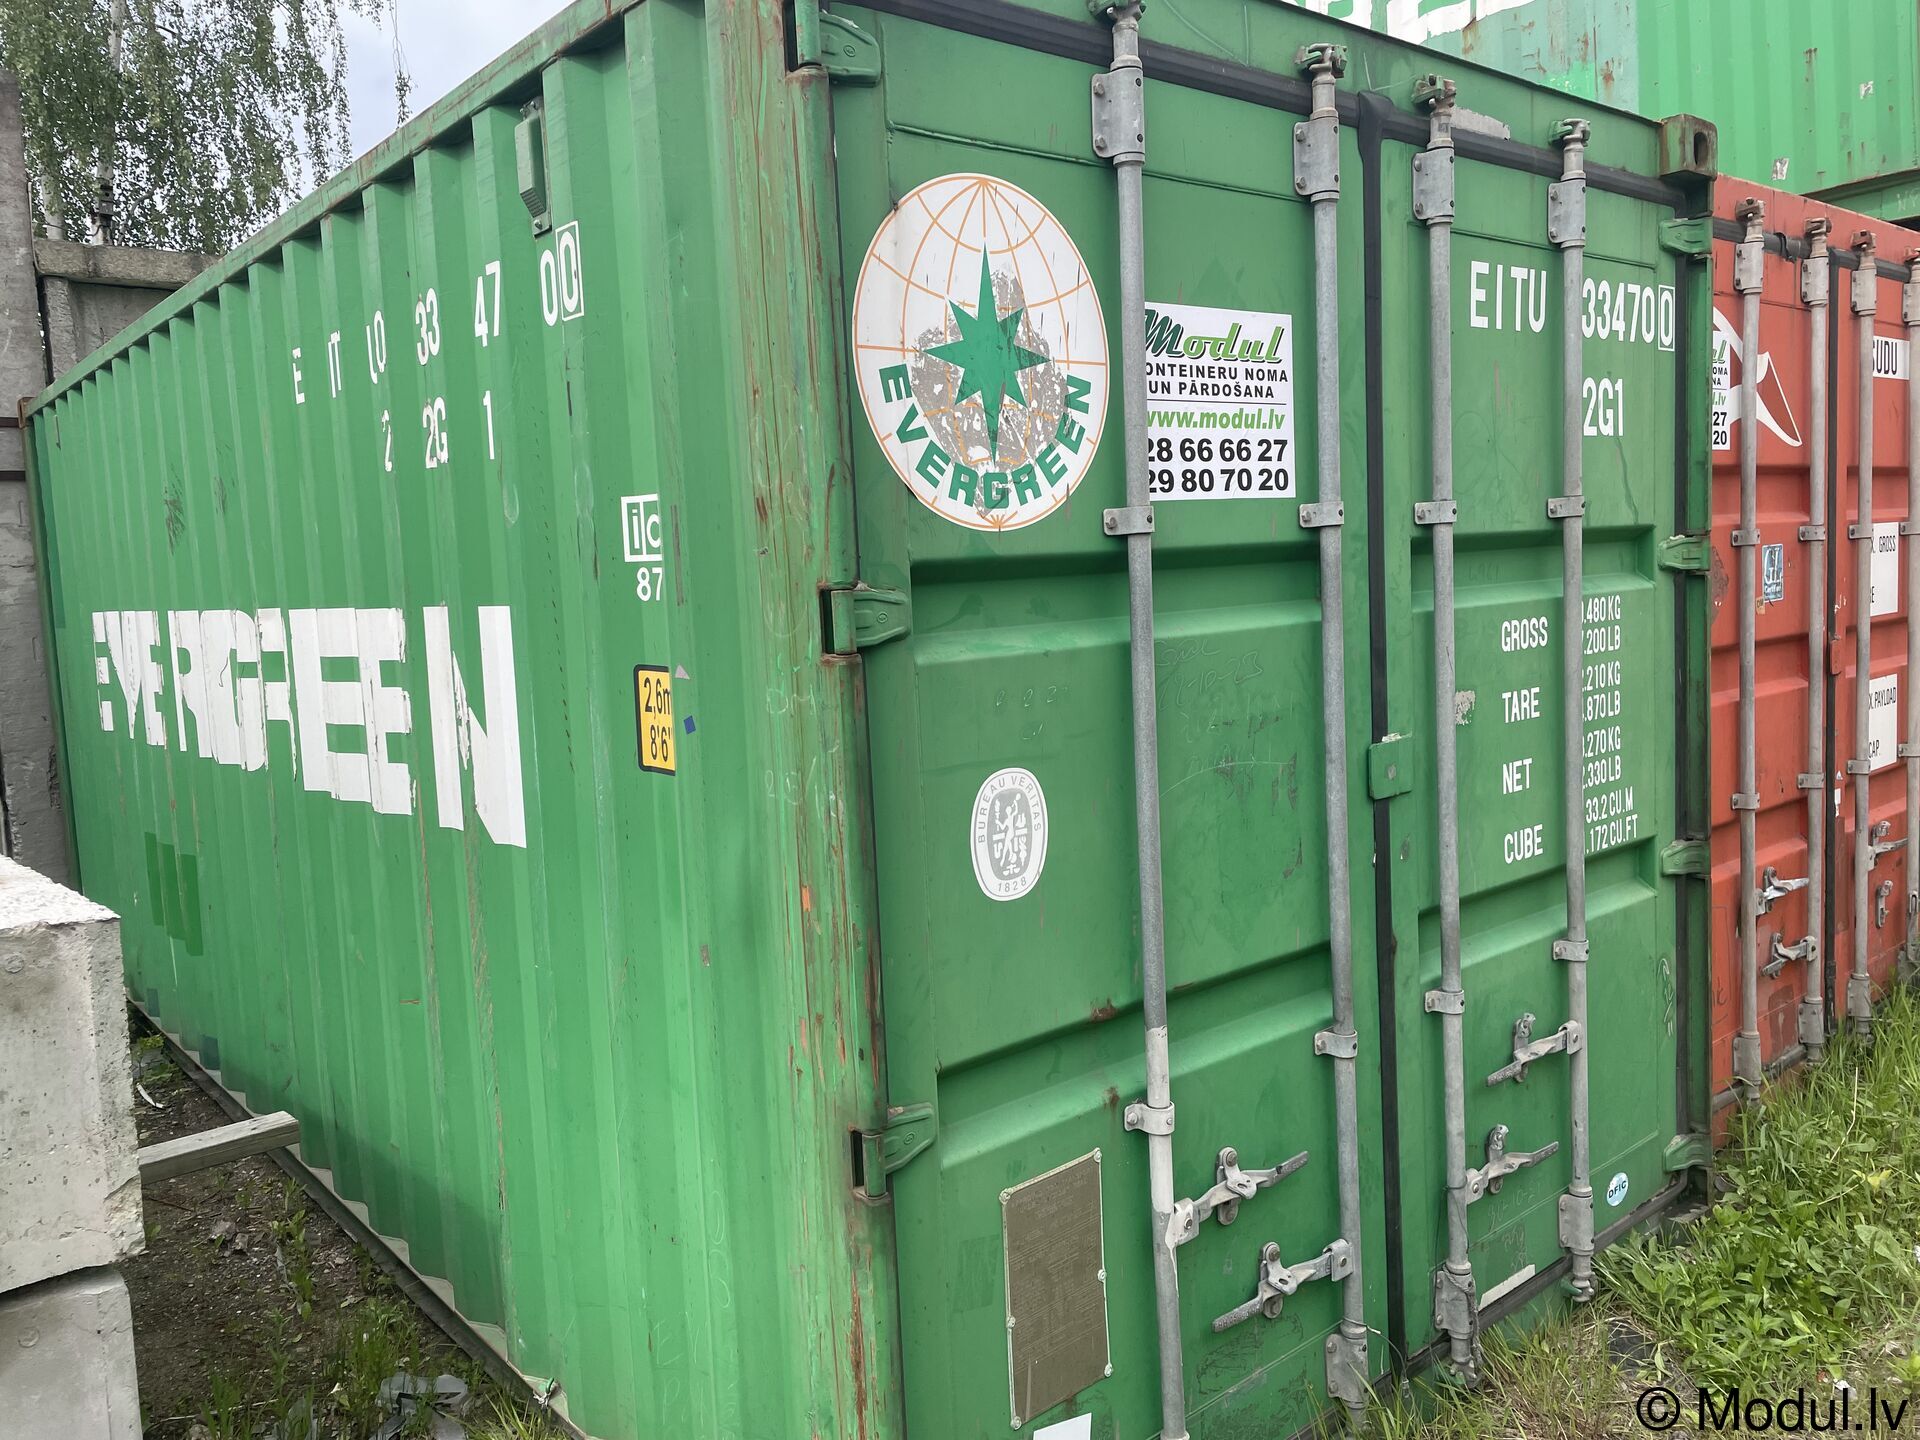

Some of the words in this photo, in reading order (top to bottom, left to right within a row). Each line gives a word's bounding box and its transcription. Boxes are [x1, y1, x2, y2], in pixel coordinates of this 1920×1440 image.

[1471, 261, 1547, 333] EITU
[1145, 308, 1285, 364] Modul
[1146, 362, 1238, 380] ONTEINERU
[1245, 368, 1288, 382] NOMA
[1712, 366, 1728, 376] OMA
[1149, 380, 1171, 395] UN
[1178, 380, 1274, 399] PĀRDOŠANA
[1582, 376, 1624, 437] 2G1
[879, 362, 1093, 510] EVERGREEN
[1179, 437, 1213, 463] 66
[1219, 438, 1252, 463] 66
[1257, 438, 1288, 462] 27
[1181, 468, 1215, 493] 80
[1220, 468, 1252, 492] 70
[1258, 468, 1289, 491] 20
[636, 567, 662, 601] 87
[1581, 597, 1606, 624] .480
[1608, 595, 1620, 621] KG
[1501, 616, 1548, 652] GROSS
[1581, 627, 1606, 655] .200
[1608, 624, 1620, 651] LB
[1608, 660, 1620, 687] KG
[1501, 687, 1540, 723] TARE
[1582, 693, 1606, 722] .870
[1608, 690, 1620, 717] LB
[1582, 729, 1606, 758] .270
[1608, 725, 1621, 752] KG
[1503, 758, 1533, 794] NET
[1608, 755, 1621, 782] LB
[978, 777, 1006, 844] BUREAU
[1011, 775, 1042, 832] VERITAS
[1586, 794, 1607, 824] 33.2
[1504, 824, 1543, 864] CUBE
[997, 876, 1027, 893] 1828
